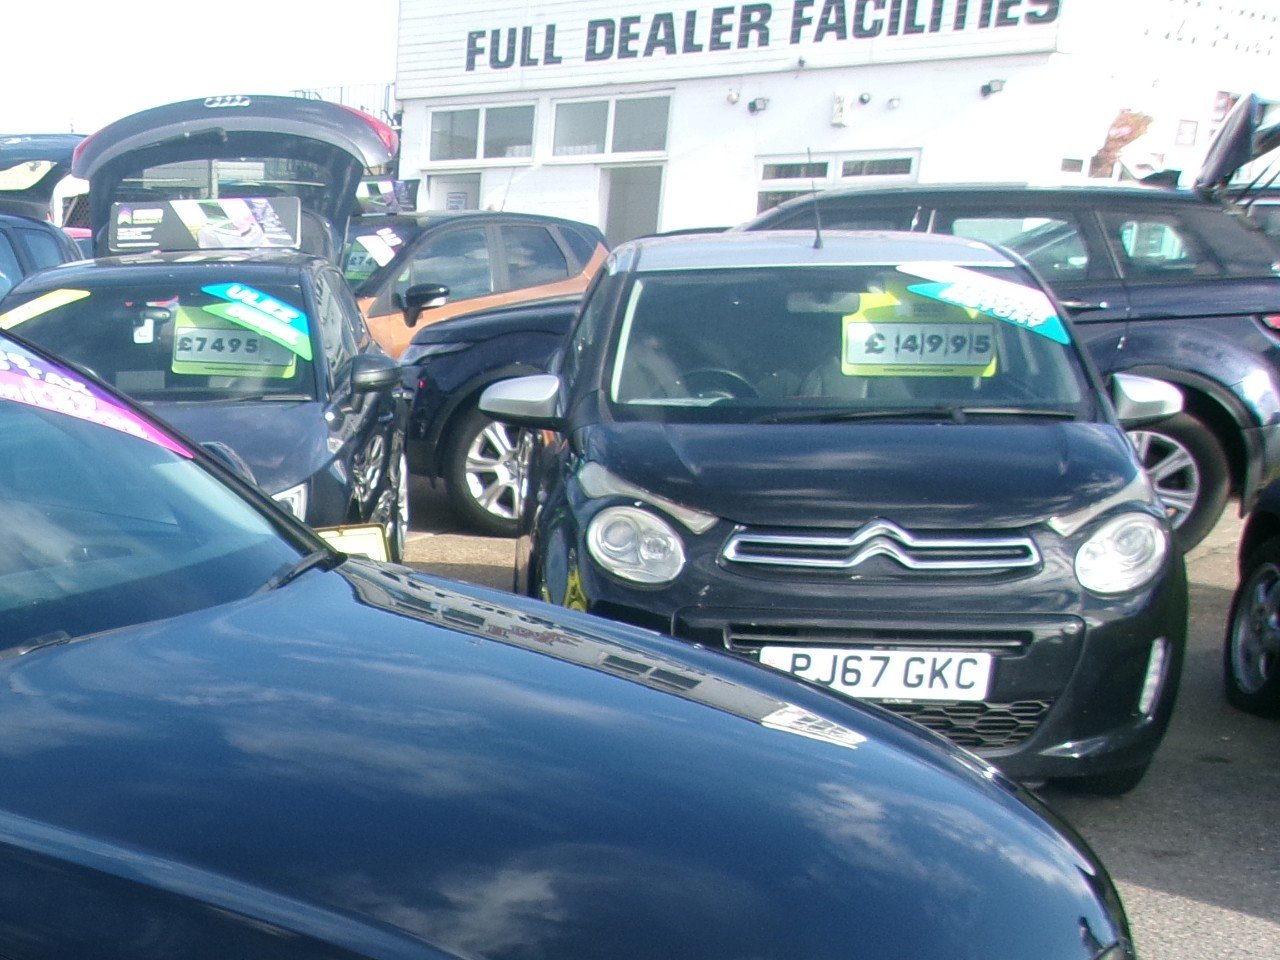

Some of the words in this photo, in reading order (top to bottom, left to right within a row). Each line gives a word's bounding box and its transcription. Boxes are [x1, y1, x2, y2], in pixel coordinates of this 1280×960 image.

[465, 24, 562, 71] FULL
[585, 3, 773, 62] DEALER
[178, 337, 258, 354] £7495
[790, 653, 890, 687] PJ67
[903, 656, 978, 690] GKC
